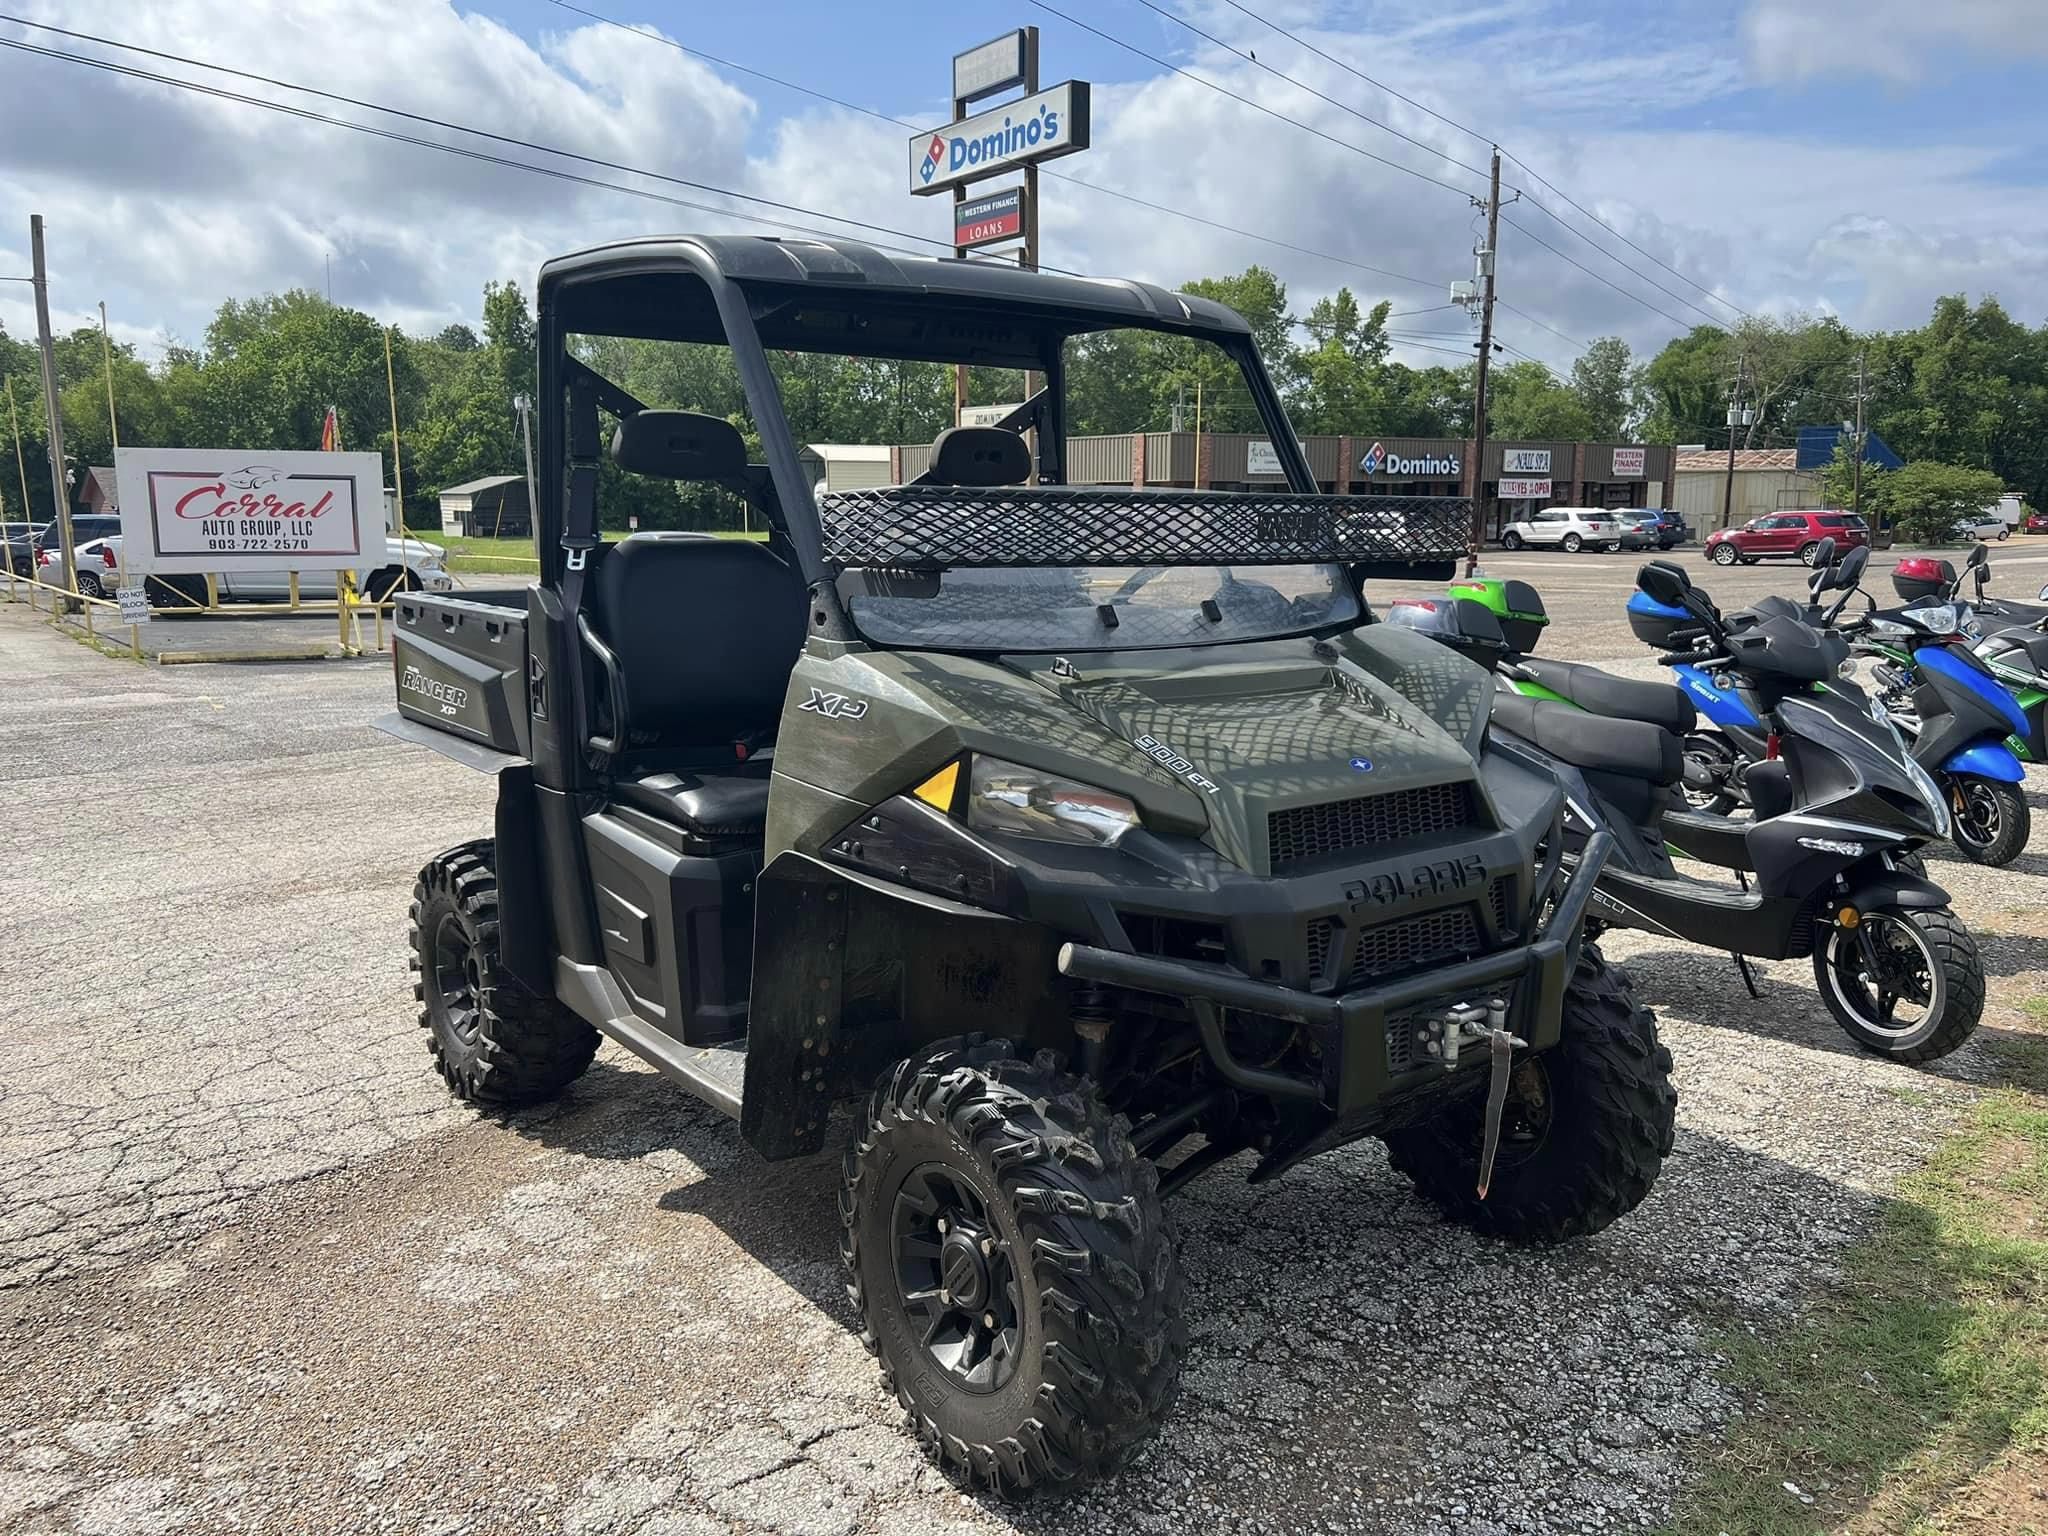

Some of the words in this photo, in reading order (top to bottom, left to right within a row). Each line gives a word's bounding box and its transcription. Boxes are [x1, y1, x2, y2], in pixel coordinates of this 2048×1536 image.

[949, 104, 1058, 172] Domino's
[964, 204, 991, 217] WESTERN
[992, 197, 1018, 212] FINANCE
[969, 221, 1003, 240] LOANS
[1386, 453, 1460, 475] Domino's
[1515, 453, 1534, 470] NAIL
[1534, 453, 1549, 470] SPA
[1615, 451, 1643, 459] WESTERN
[1615, 460, 1642, 468] FINANCE
[1534, 482, 1550, 495] OPEN
[175, 482, 333, 519] Corral
[202, 520, 235, 536] AUTO
[240, 520, 287, 538] GROUP,
[291, 520, 313, 536] LLC
[209, 539, 309, 550] 903-722-2570
[402, 670, 468, 708] RANGER
[440, 703, 457, 715] XP
[797, 686, 868, 719] XP
[1134, 734, 1194, 774] 900
[1186, 772, 1221, 794] EFI
[1340, 854, 1488, 913] POLARIS
